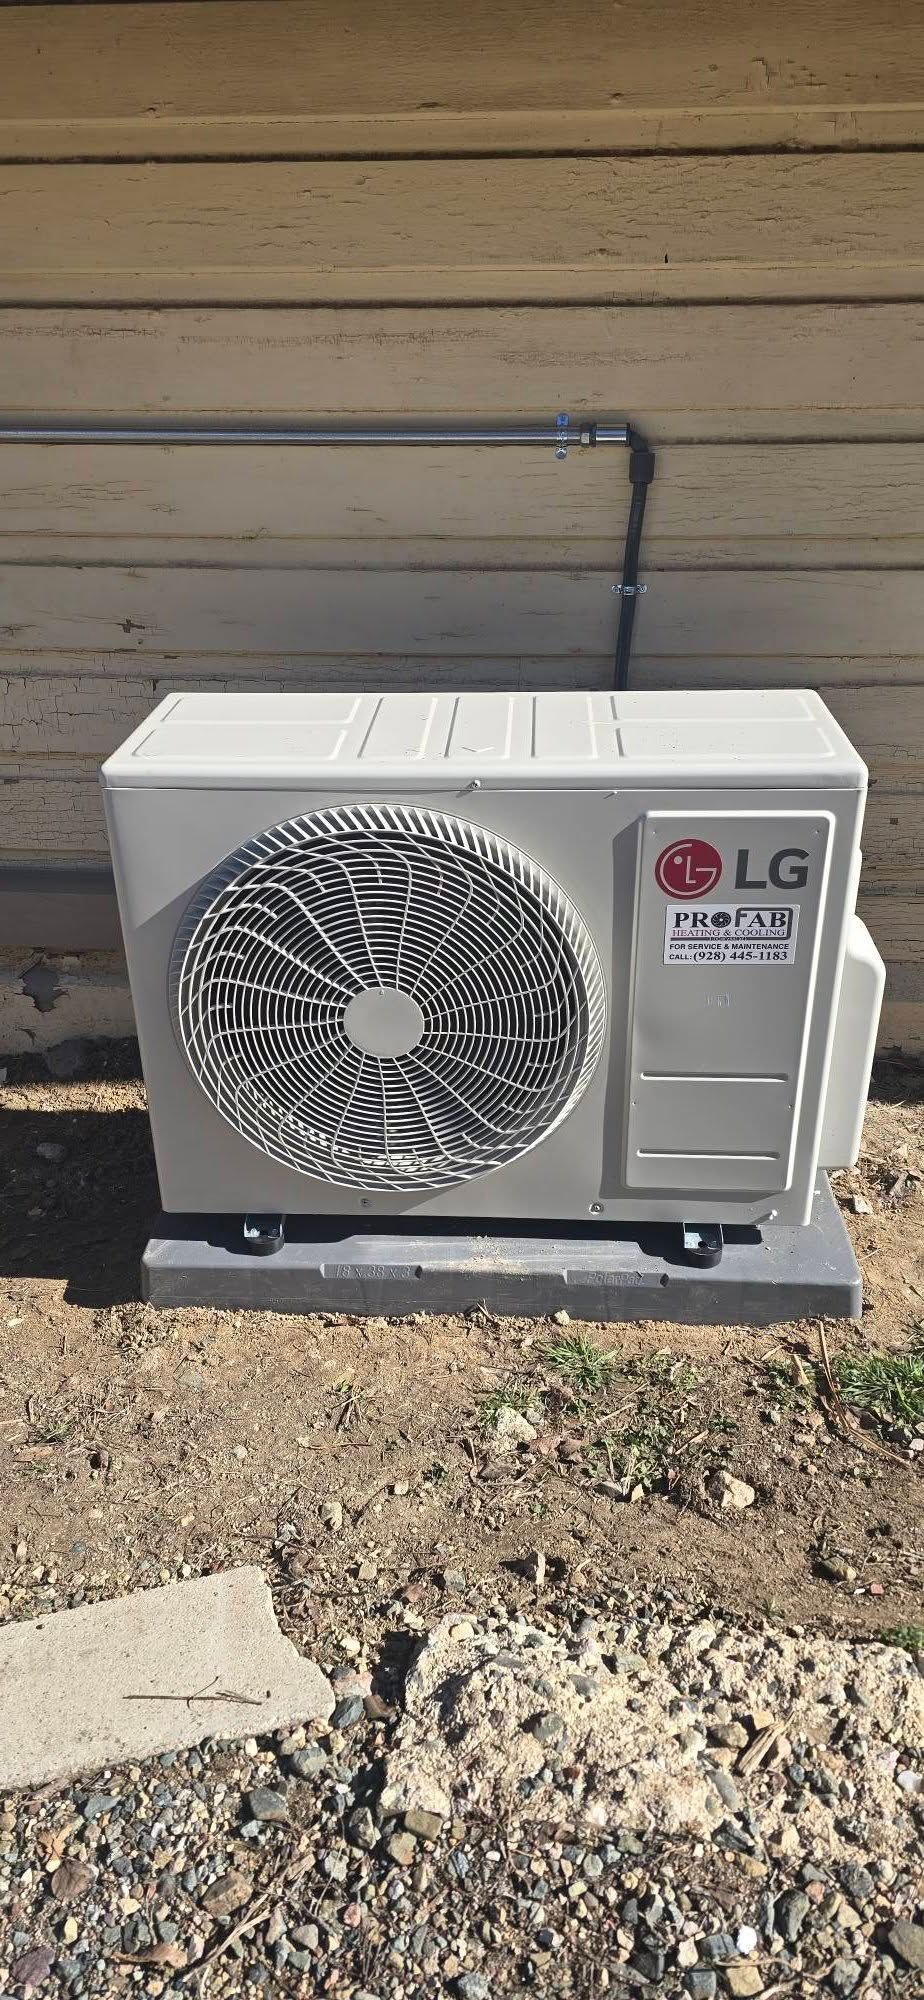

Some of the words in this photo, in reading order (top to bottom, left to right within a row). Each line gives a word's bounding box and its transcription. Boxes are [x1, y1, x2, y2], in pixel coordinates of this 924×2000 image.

[735, 848, 810, 889] LG
[672, 929, 720, 937] HEATING
[722, 929, 731, 937] &
[734, 929, 785, 937] COOLING
[693, 951, 726, 962] (928)
[729, 951, 788, 961] 445-1183
[336, 1265, 350, 1278] 18
[368, 1266, 385, 1278] 38
